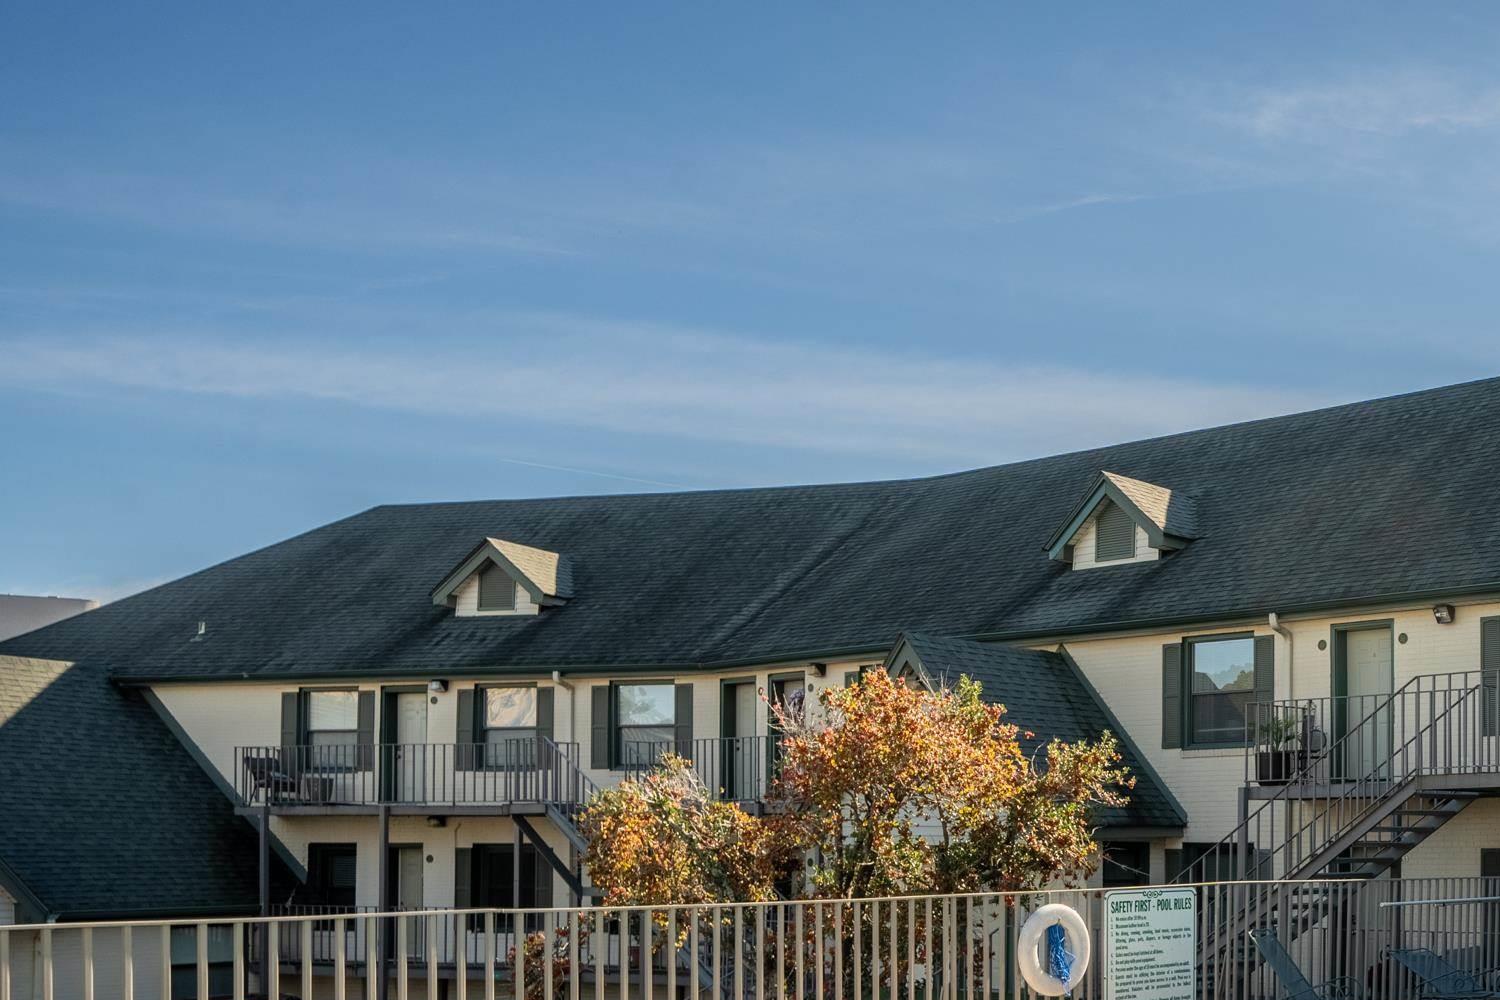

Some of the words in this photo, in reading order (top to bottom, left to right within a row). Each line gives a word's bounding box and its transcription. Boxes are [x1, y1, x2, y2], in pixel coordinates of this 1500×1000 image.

[1111, 901, 1133, 913] SAFETY
[1134, 900, 1151, 912] FIRST
[1157, 899, 1172, 911] POOL
[1174, 897, 1192, 910] RULES
